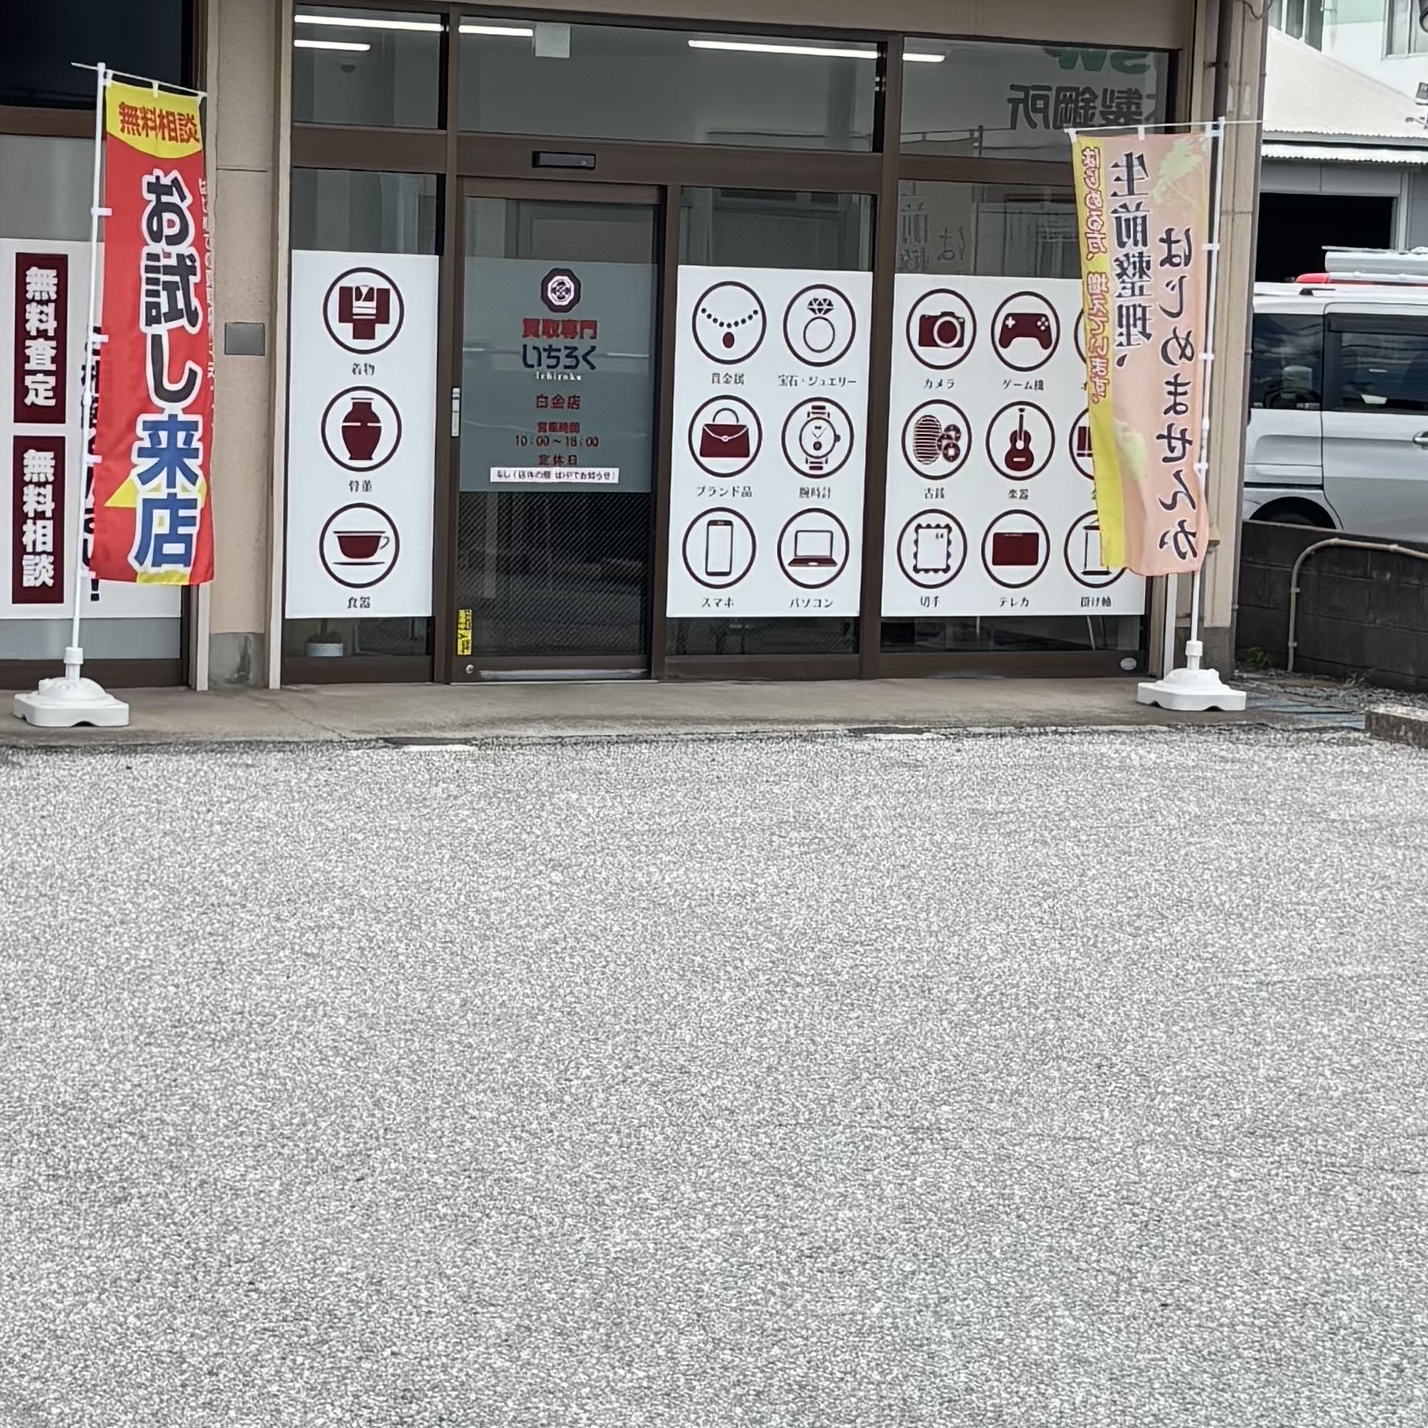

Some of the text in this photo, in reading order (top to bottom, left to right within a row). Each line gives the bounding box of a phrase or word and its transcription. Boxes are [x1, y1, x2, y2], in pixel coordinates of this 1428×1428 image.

[118, 101, 200, 144] 無料相談
[24, 266, 58, 407] 無料査定
[522, 318, 598, 340] 買取専門
[522, 344, 597, 371] いちろく
[133, 169, 204, 573] お試し来店
[923, 378, 956, 390] カメラ
[696, 485, 753, 498] ブランド品
[22, 449, 56, 588] 無料相談
[701, 596, 735, 609] スマホ
[789, 597, 834, 609] パソコン
